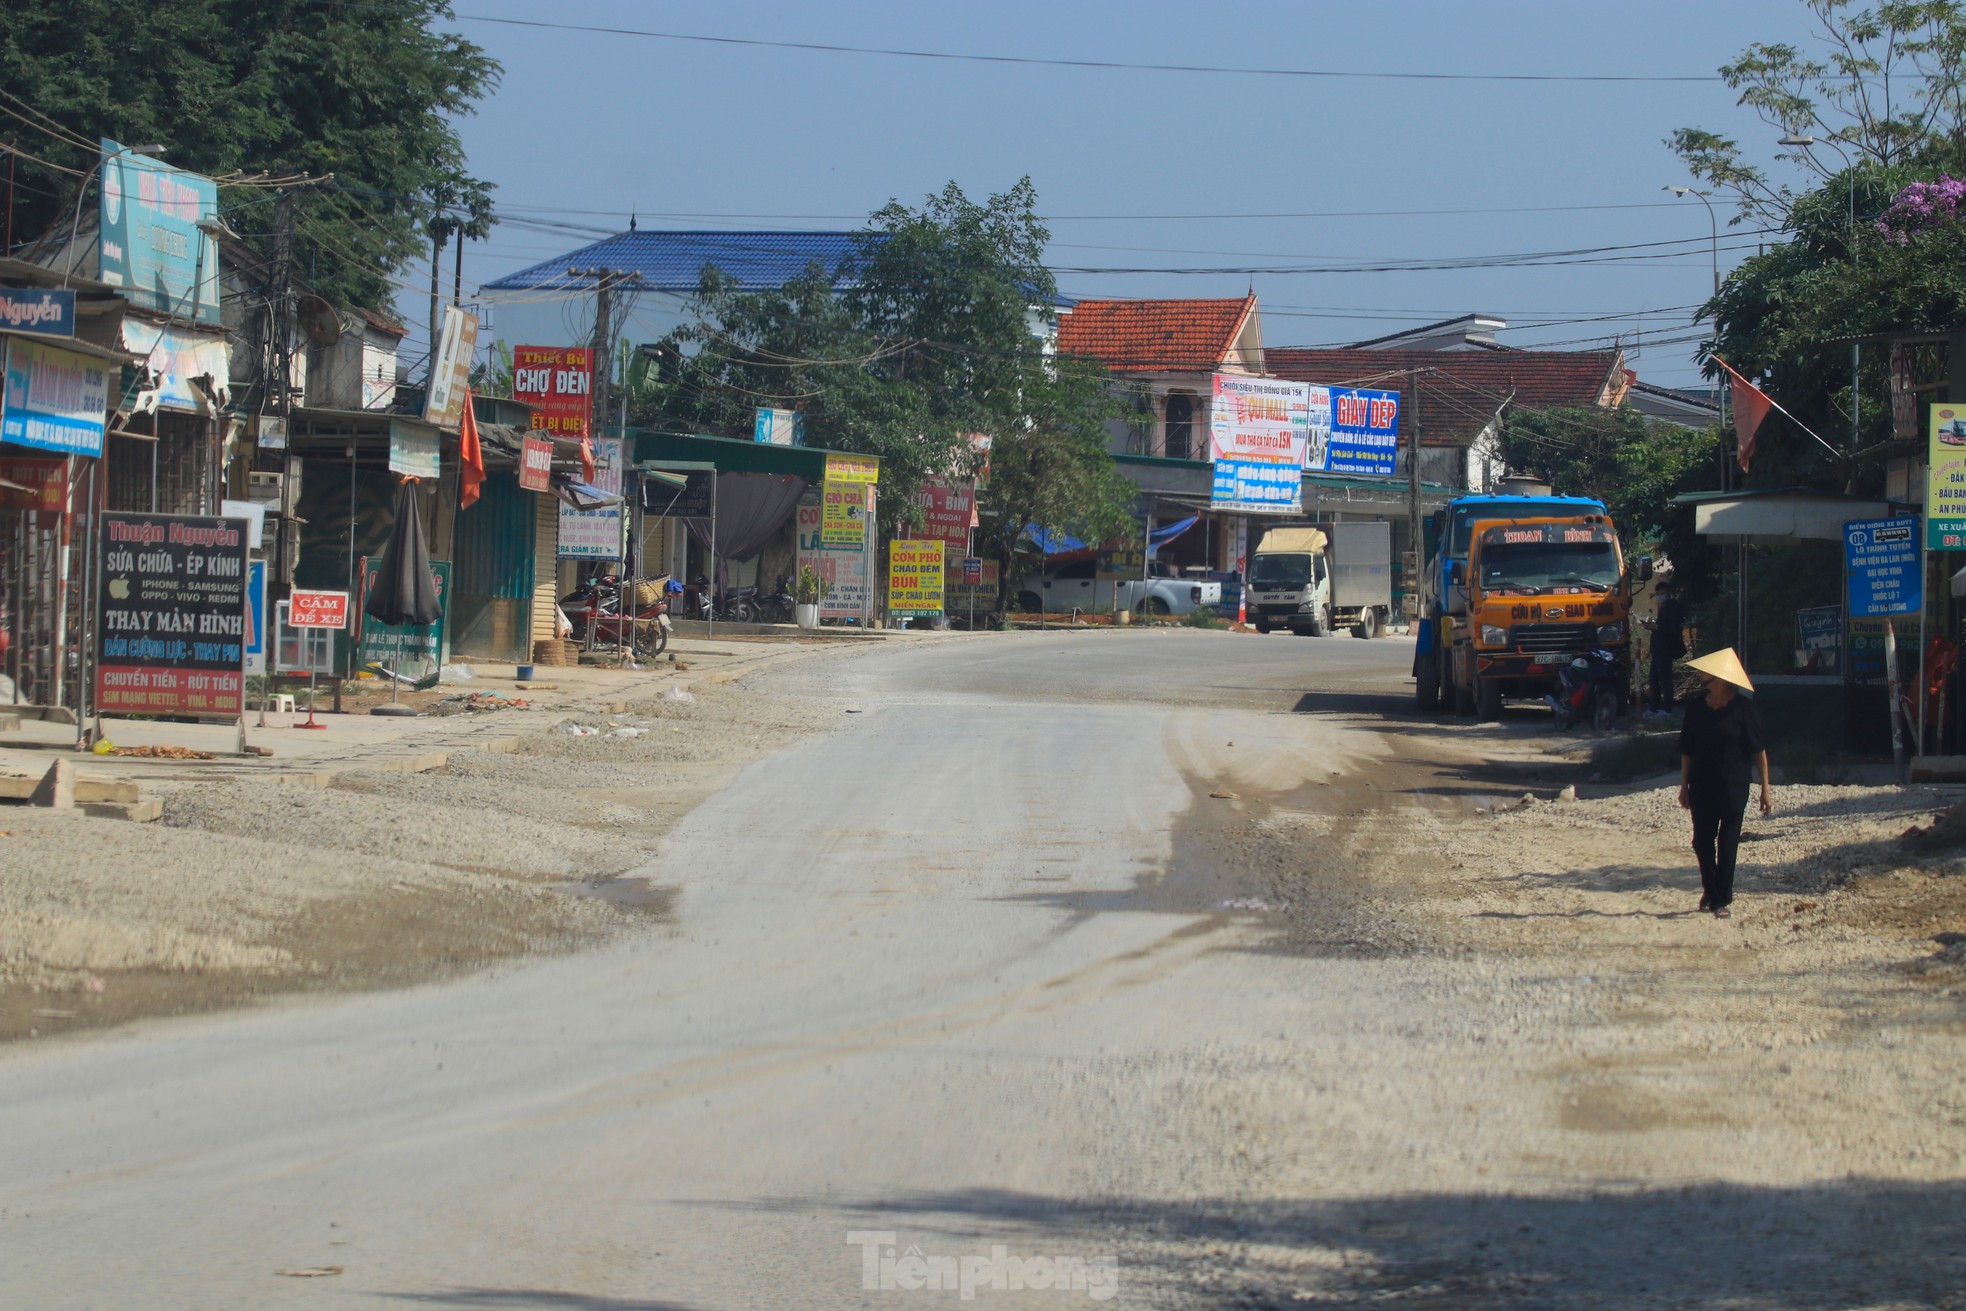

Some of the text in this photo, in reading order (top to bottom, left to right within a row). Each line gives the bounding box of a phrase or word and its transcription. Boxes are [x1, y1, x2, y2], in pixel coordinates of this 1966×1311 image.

[516, 367, 590, 397] CHỢ ĐÈN
[1337, 390, 1368, 428] GIÀY
[1370, 393, 1396, 428] DÉP
[548, 417, 558, 432] BỊ
[1279, 431, 1291, 448] 15K
[1939, 504, 1949, 514] AN
[109, 520, 239, 547] Thuận Nguyễn
[1564, 528, 1592, 542] BÌNH
[1852, 534, 1865, 544] 08
[1866, 544, 1887, 552] TRÌNH
[107, 544, 240, 576] SỬA CHỮA ÉP KÍNH
[893, 551, 916, 562] CƠM
[919, 549, 942, 562] PHỞ
[893, 564, 940, 572] CHÁO ĐÊM
[142, 580, 240, 592] IPHONE SAMSUNG
[892, 574, 918, 588] BÚN
[142, 591, 239, 604] OPPO VIVO REDMI
[299, 595, 338, 608] CẤM
[294, 610, 342, 624] ĐỂ XE
[1512, 603, 1542, 622] CỨU HỘ
[1565, 604, 1585, 617] GIAO
[106, 607, 242, 635] THAY MÀN HÌNH
[104, 634, 240, 664] DÁN CƯỜNG LỰC THAY PIN
[104, 668, 238, 690] CHUYỂN TIỀN RÚT TIỀN
[102, 691, 237, 708] SIM MẠNG VIETTEL VINA MOBI
